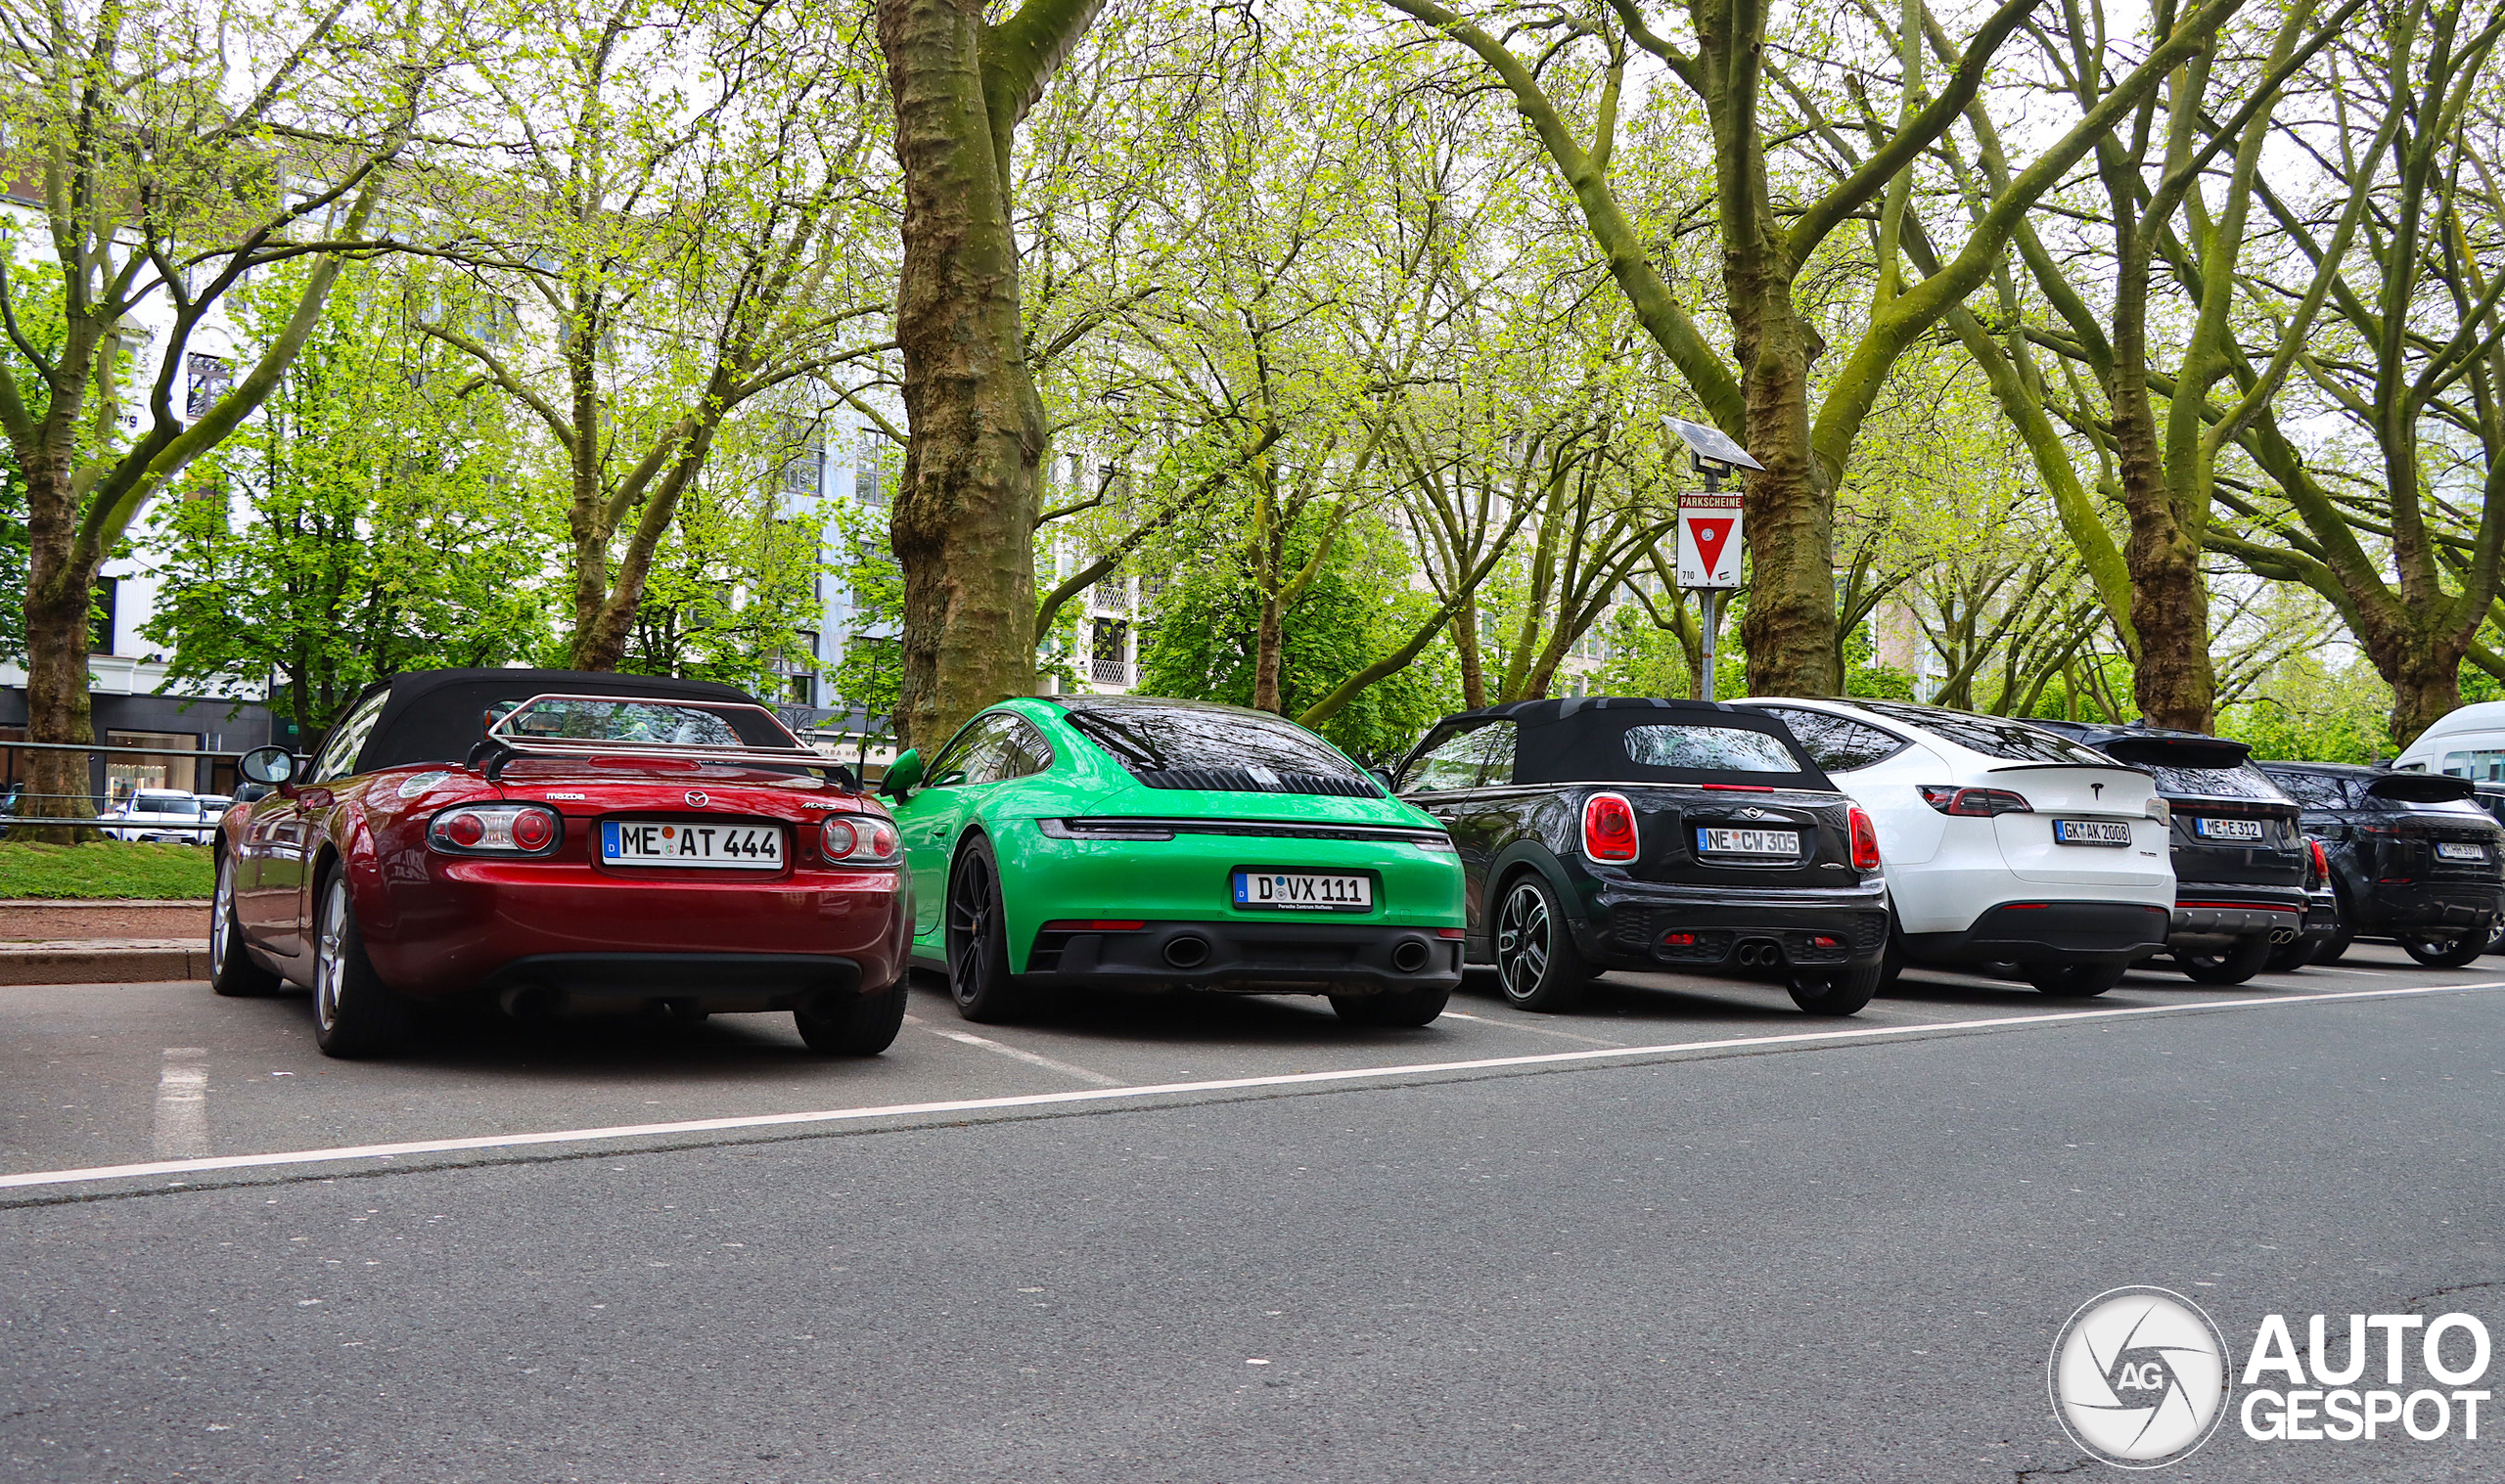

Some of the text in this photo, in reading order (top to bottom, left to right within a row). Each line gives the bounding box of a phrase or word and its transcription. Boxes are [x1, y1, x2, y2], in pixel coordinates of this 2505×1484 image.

[1680, 497, 1741, 508] PARKSCHEINE
[1682, 570, 1695, 580] 710
[801, 802, 838, 811] MX-5
[2065, 823, 2128, 841] GK AK 2008
[2207, 820, 2258, 836] ME E 312
[609, 843, 615, 852] D
[621, 827, 777, 858] ME AT 444
[1708, 831, 1798, 852] NE CW 305
[1258, 877, 1362, 902] D VX 111
